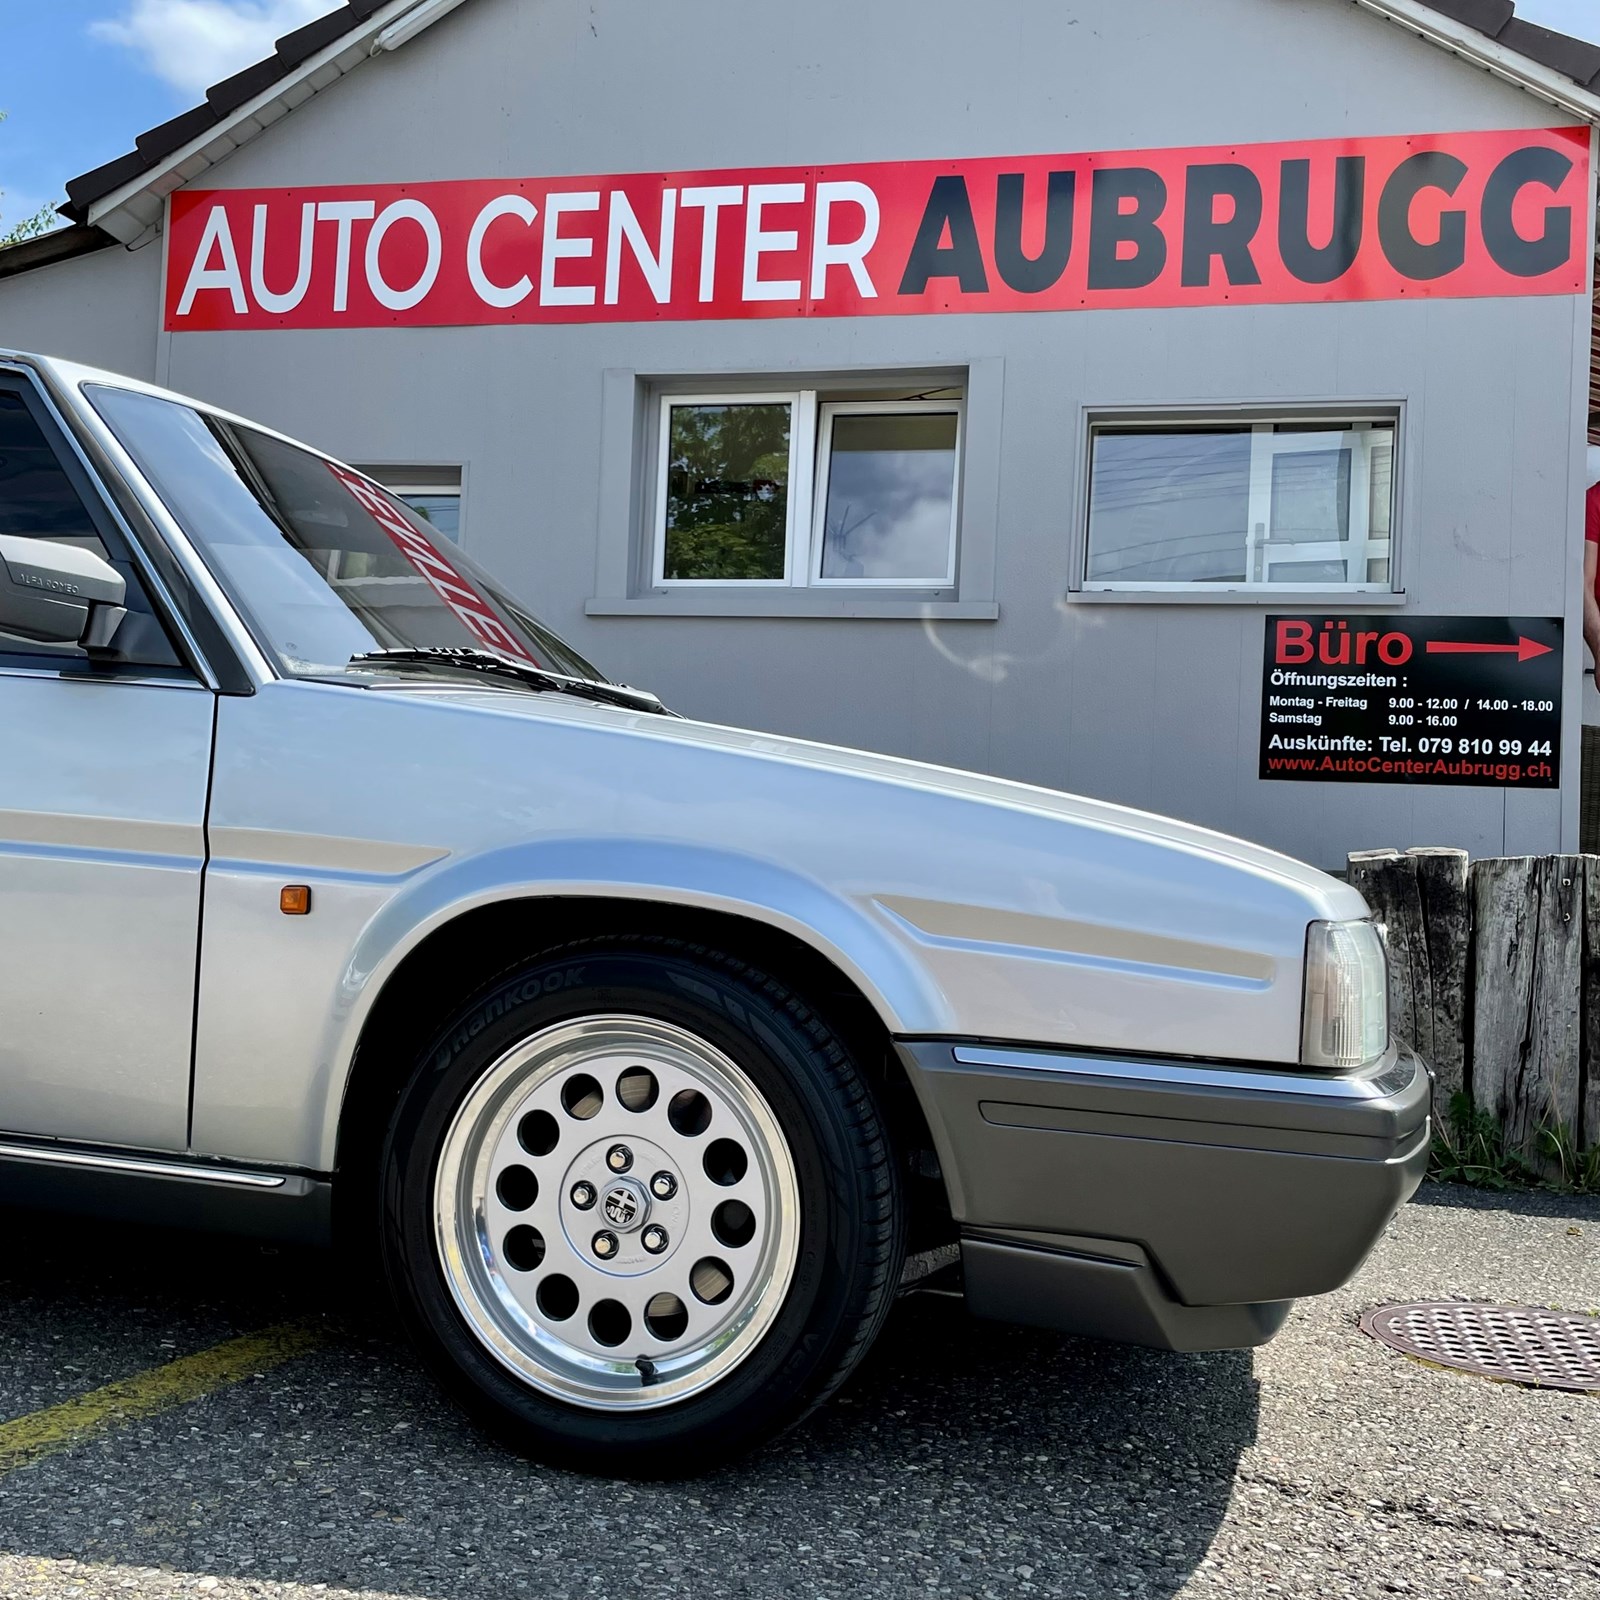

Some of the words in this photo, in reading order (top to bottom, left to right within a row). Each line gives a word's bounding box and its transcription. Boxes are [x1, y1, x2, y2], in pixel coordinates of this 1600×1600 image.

[176, 198, 442, 316] AUTO
[466, 180, 881, 308] CENTER
[897, 146, 1574, 296] AUBRUGG
[46, 579, 79, 594] ROMEO
[1275, 620, 1413, 666] Büro
[1270, 669, 1397, 689] Öffnungszeiten
[1269, 696, 1315, 709] Montag
[1325, 696, 1368, 710] Freitag
[1388, 698, 1414, 709] 9.00
[1426, 698, 1458, 710] 12.00
[1477, 699, 1509, 711] 14.00
[1521, 700, 1554, 712] 18.00
[1269, 712, 1322, 726] Samstag
[1388, 714, 1414, 726] 9.00
[1426, 715, 1458, 727] 16.00
[1268, 733, 1373, 752] Auskünfte:
[1379, 736, 1412, 753] Tel.
[1418, 737, 1453, 754] 079
[1458, 738, 1493, 755] 810
[1499, 739, 1522, 756] 99
[1527, 740, 1552, 757] 44
[1268, 756, 1552, 780] www.AutoCenterAubrugg.ch
